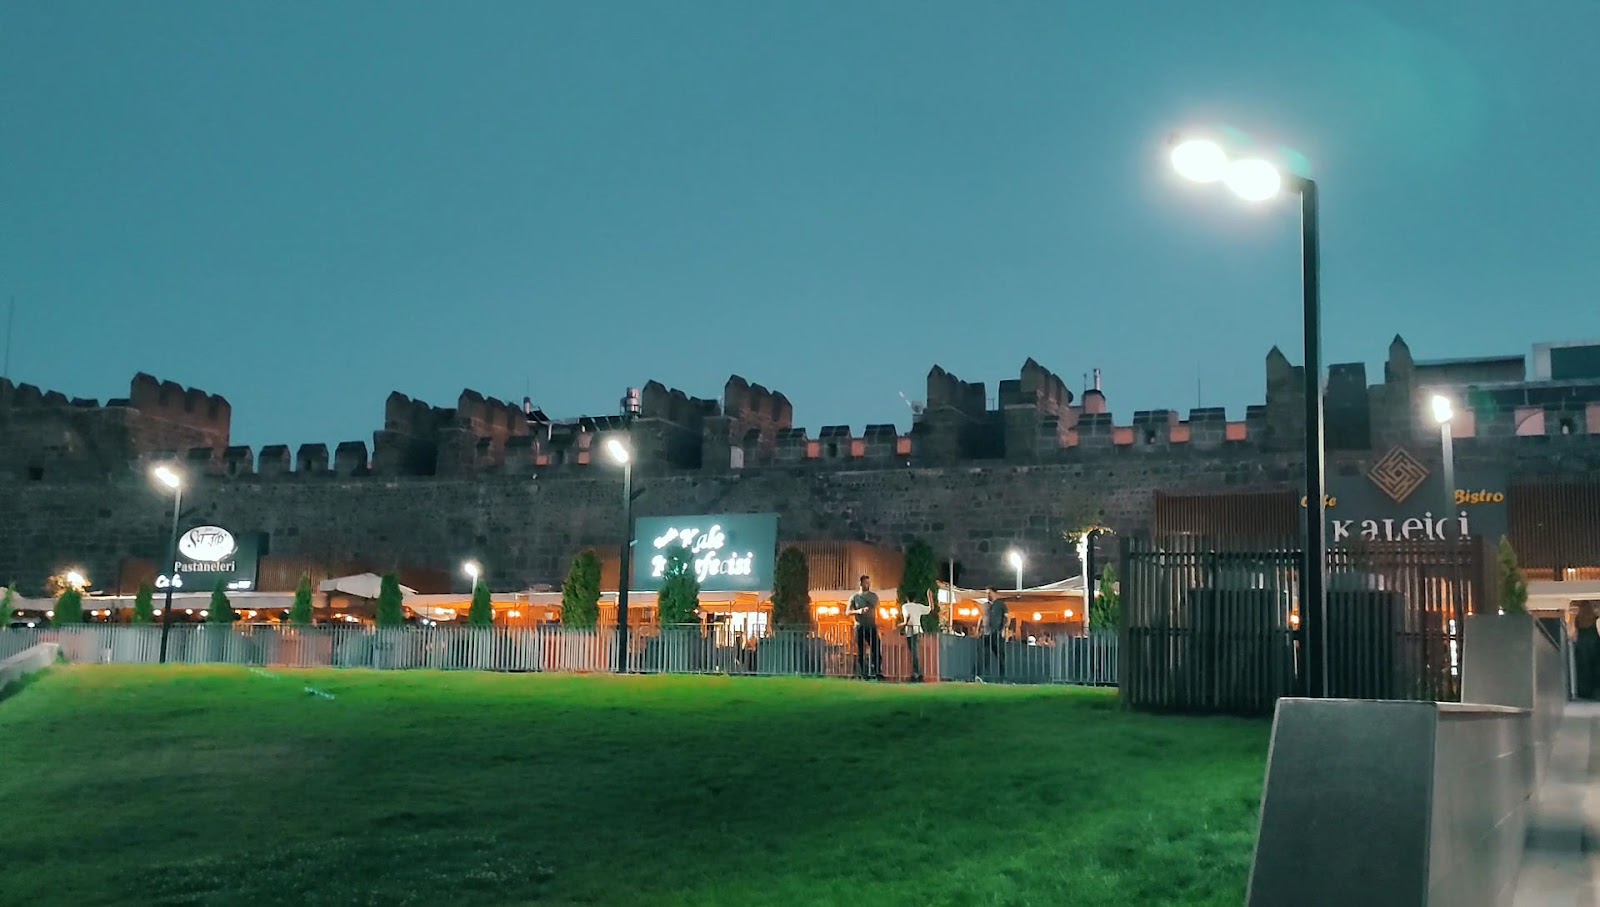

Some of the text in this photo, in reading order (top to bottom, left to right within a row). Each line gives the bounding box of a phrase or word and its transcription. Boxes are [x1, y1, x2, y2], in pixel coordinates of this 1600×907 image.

[1300, 493, 1338, 510] Cfe
[1453, 489, 1504, 505] Bistro
[174, 560, 236, 572] Pastaneleri
